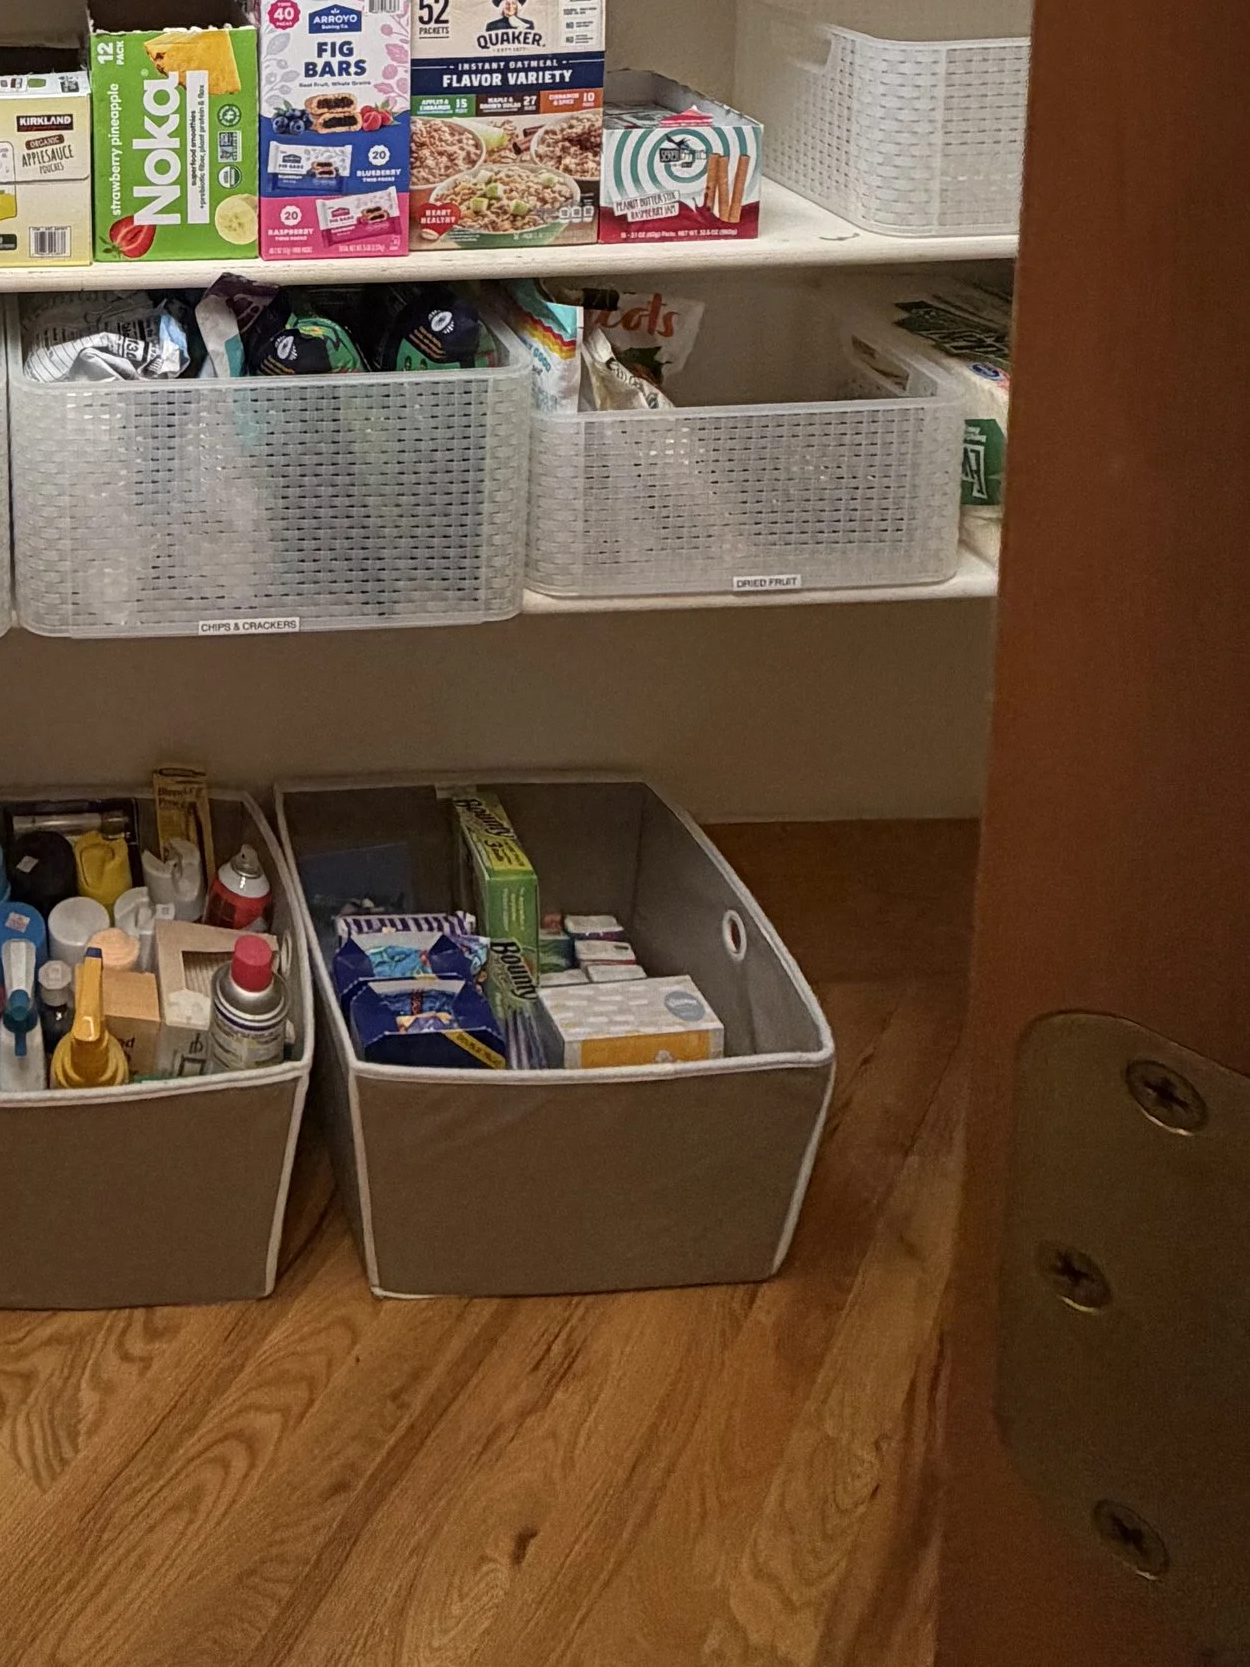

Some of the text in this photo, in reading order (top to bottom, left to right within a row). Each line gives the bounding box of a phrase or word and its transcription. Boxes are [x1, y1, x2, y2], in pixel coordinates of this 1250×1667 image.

[273, 7, 295, 21] 40
[313, 14, 358, 25] ARROYO
[418, 26, 450, 35] PACKETS
[476, 30, 543, 50] QUAKER
[97, 41, 114, 65] 12
[116, 40, 125, 65] PACK
[316, 40, 354, 59] FIG
[304, 59, 367, 78] BARS
[458, 59, 559, 71] INSTANT OATMEAL
[442, 69, 573, 88] FLAVOR VARIETY
[455, 98, 468, 108] 15
[523, 95, 538, 106] 27
[583, 92, 595, 102] 10
[19, 116, 72, 126] KIRKLAND
[29, 136, 60, 149] ORGANIC
[132, 71, 181, 226] Noka
[189, 110, 198, 186] superfood smoothies
[108, 83, 123, 216] strawberry pineapple
[372, 150, 387, 160] 20
[22, 145, 74, 168] APPLESAUCE
[39, 162, 64, 174] POUCHES
[356, 168, 402, 177] BLUEBERRY
[616, 195, 663, 212] PEANUT BUTTER
[284, 211, 299, 220] 20
[420, 216, 457, 224] HEALTHY
[267, 228, 315, 236] RASPBERRY
[736, 577, 797, 588] DRIED FRUIT
[200, 620, 298, 632] CHIPS & CRACKERS
[490, 940, 538, 1001] Bounty
